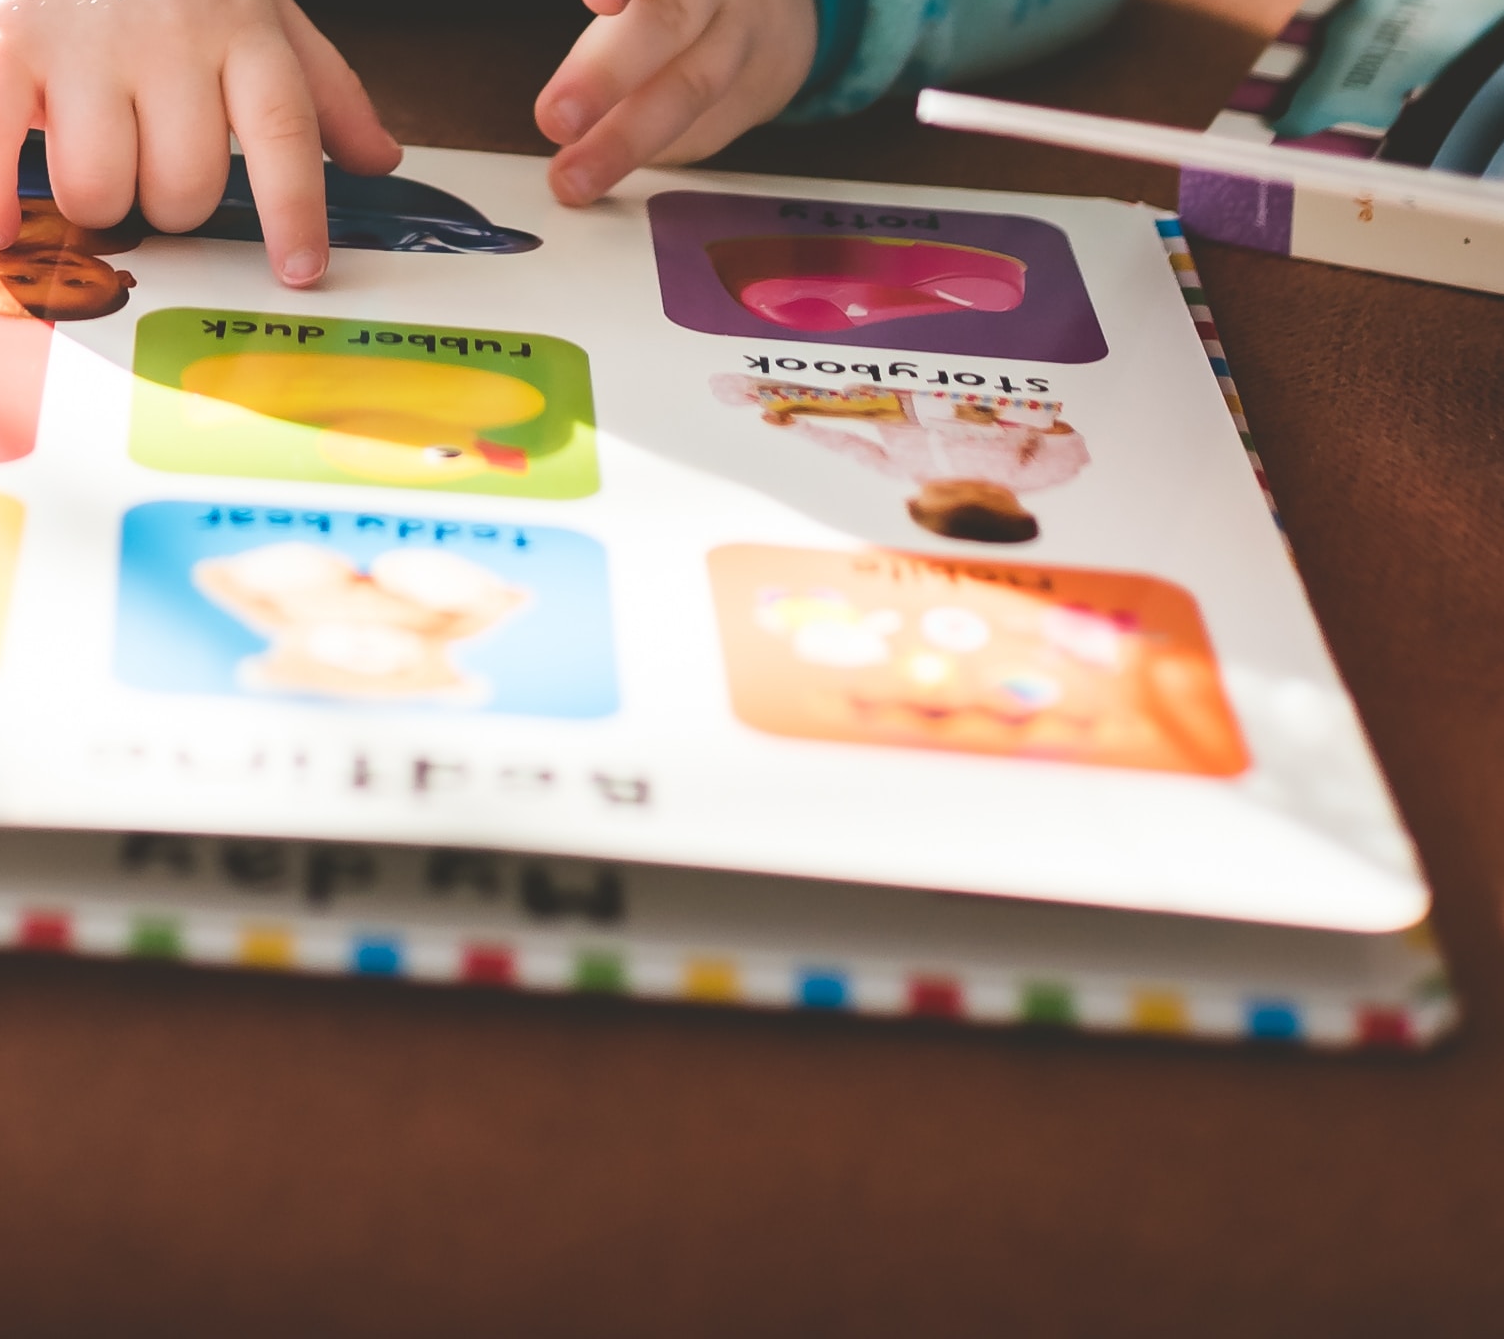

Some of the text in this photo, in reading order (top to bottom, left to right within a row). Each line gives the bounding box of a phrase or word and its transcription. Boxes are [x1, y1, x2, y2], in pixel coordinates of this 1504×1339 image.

[777, 202, 940, 230] potty
[201, 319, 532, 358] rubber duck
[742, 354, 1050, 394] storybook
[194, 506, 537, 547] teddy bear
